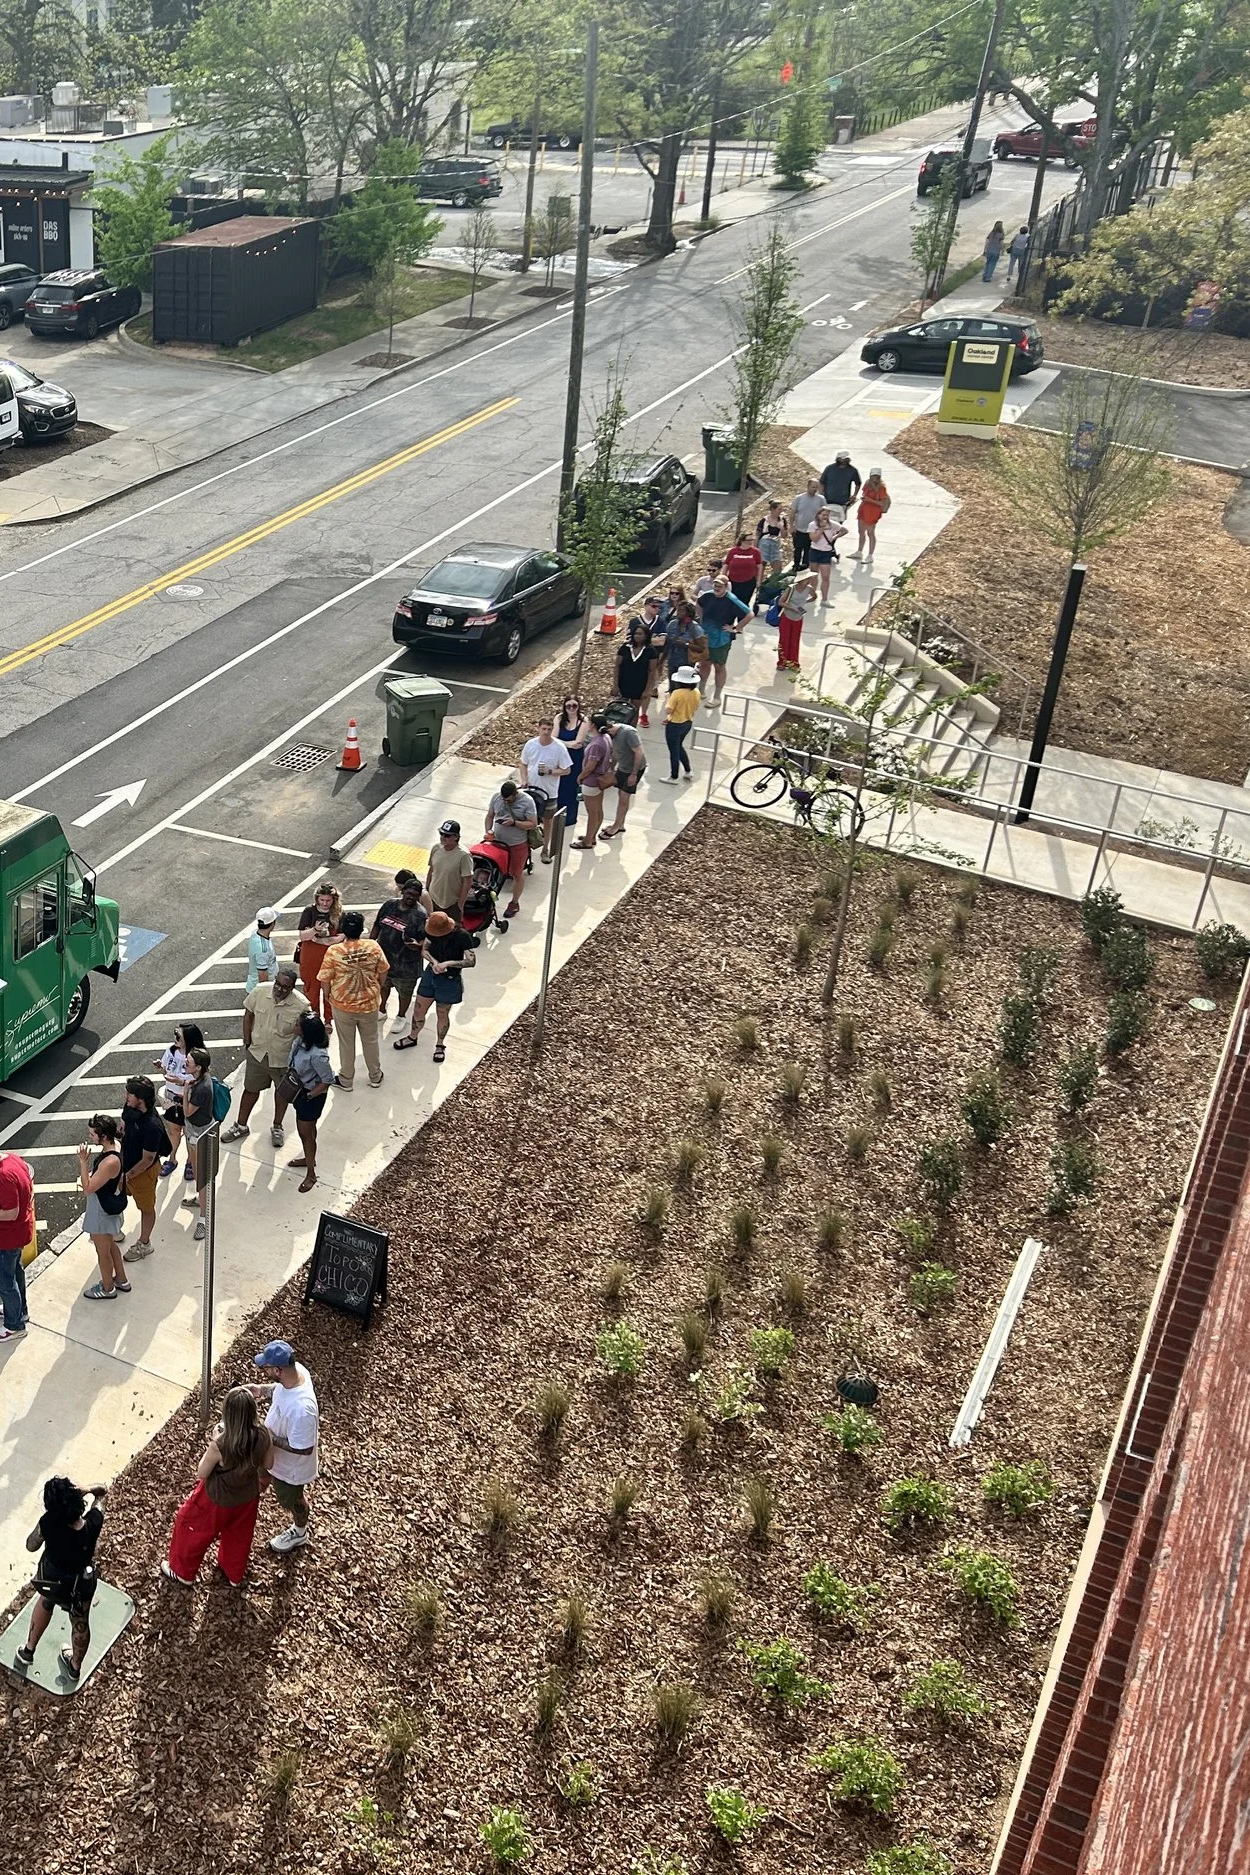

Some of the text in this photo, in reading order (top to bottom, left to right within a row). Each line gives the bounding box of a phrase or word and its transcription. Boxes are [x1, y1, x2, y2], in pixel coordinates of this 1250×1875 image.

[43, 220, 58, 231] DAS
[43, 230, 59, 241] BBQ
[317, 1264, 369, 1297] CHICO
